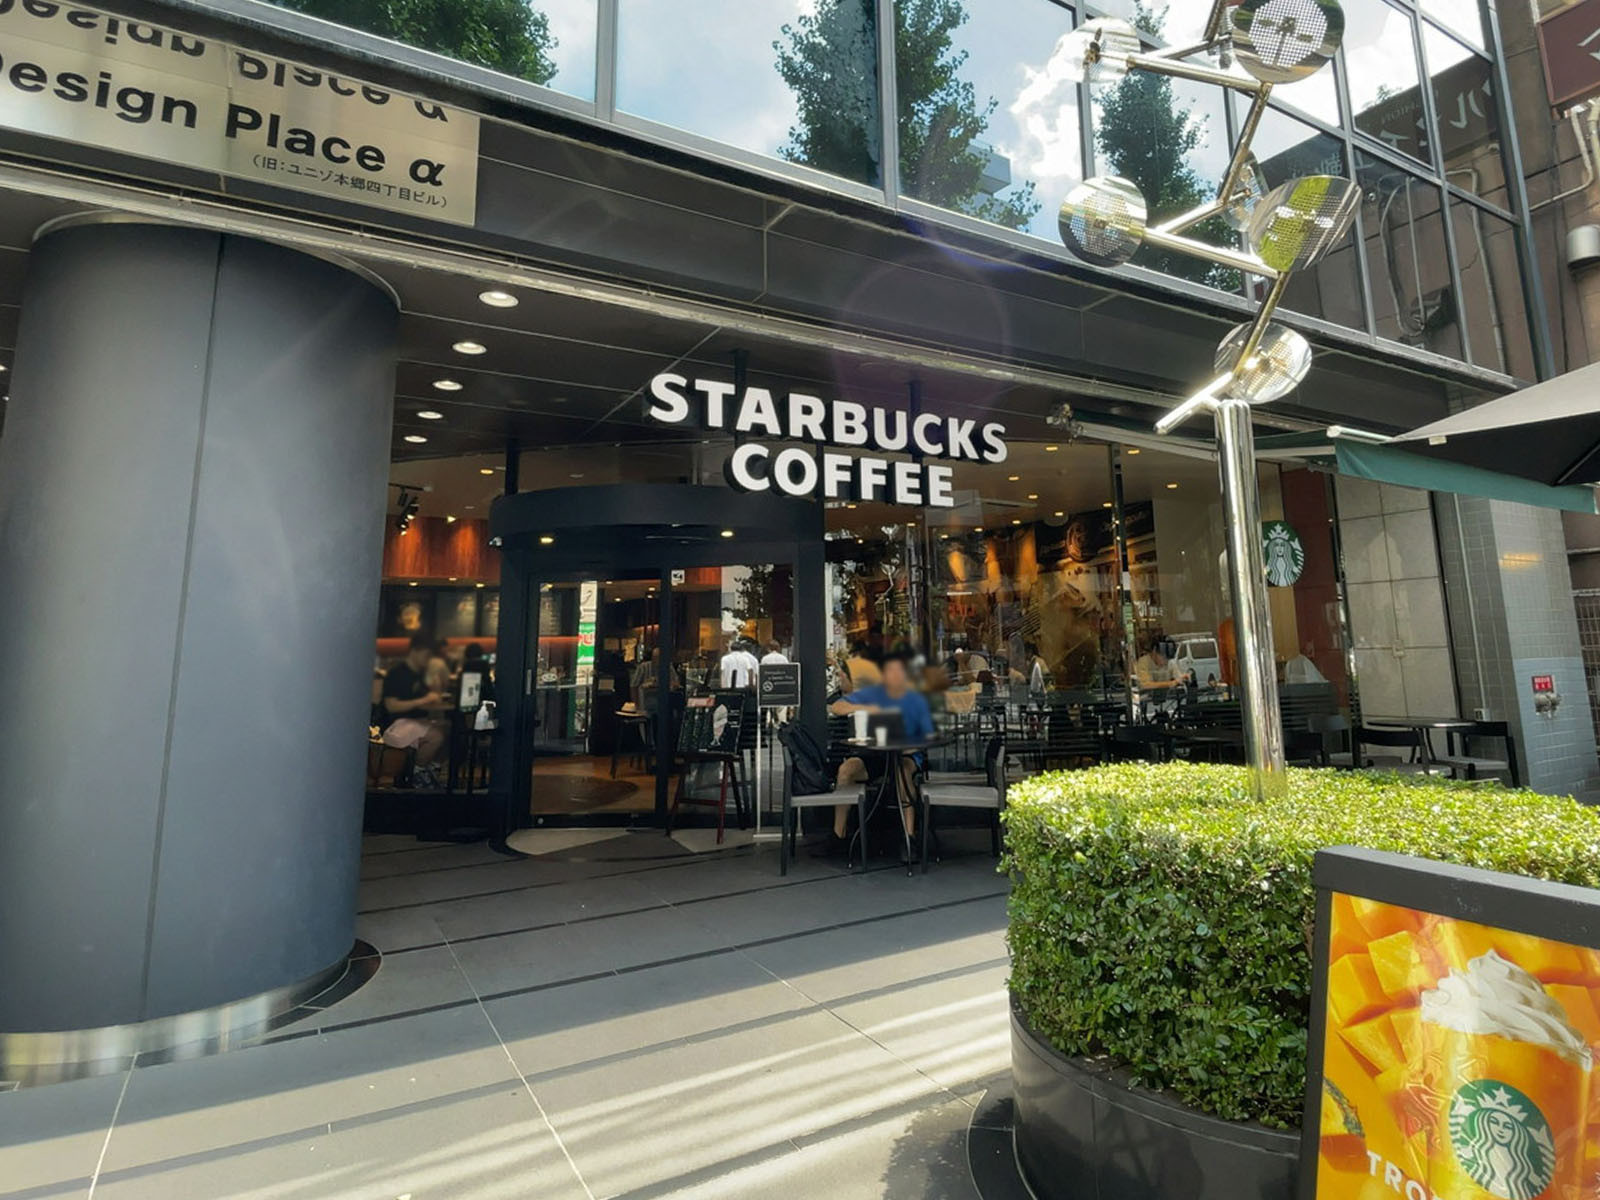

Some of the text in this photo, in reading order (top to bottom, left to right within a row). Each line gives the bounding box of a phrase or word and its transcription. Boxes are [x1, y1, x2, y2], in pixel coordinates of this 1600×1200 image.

[0, 53, 197, 129] esign
[225, 103, 386, 172] Place
[648, 373, 1009, 464] STARBUCKS
[730, 443, 955, 508] COFFEE
[1366, 1149, 1445, 1200] TRO
